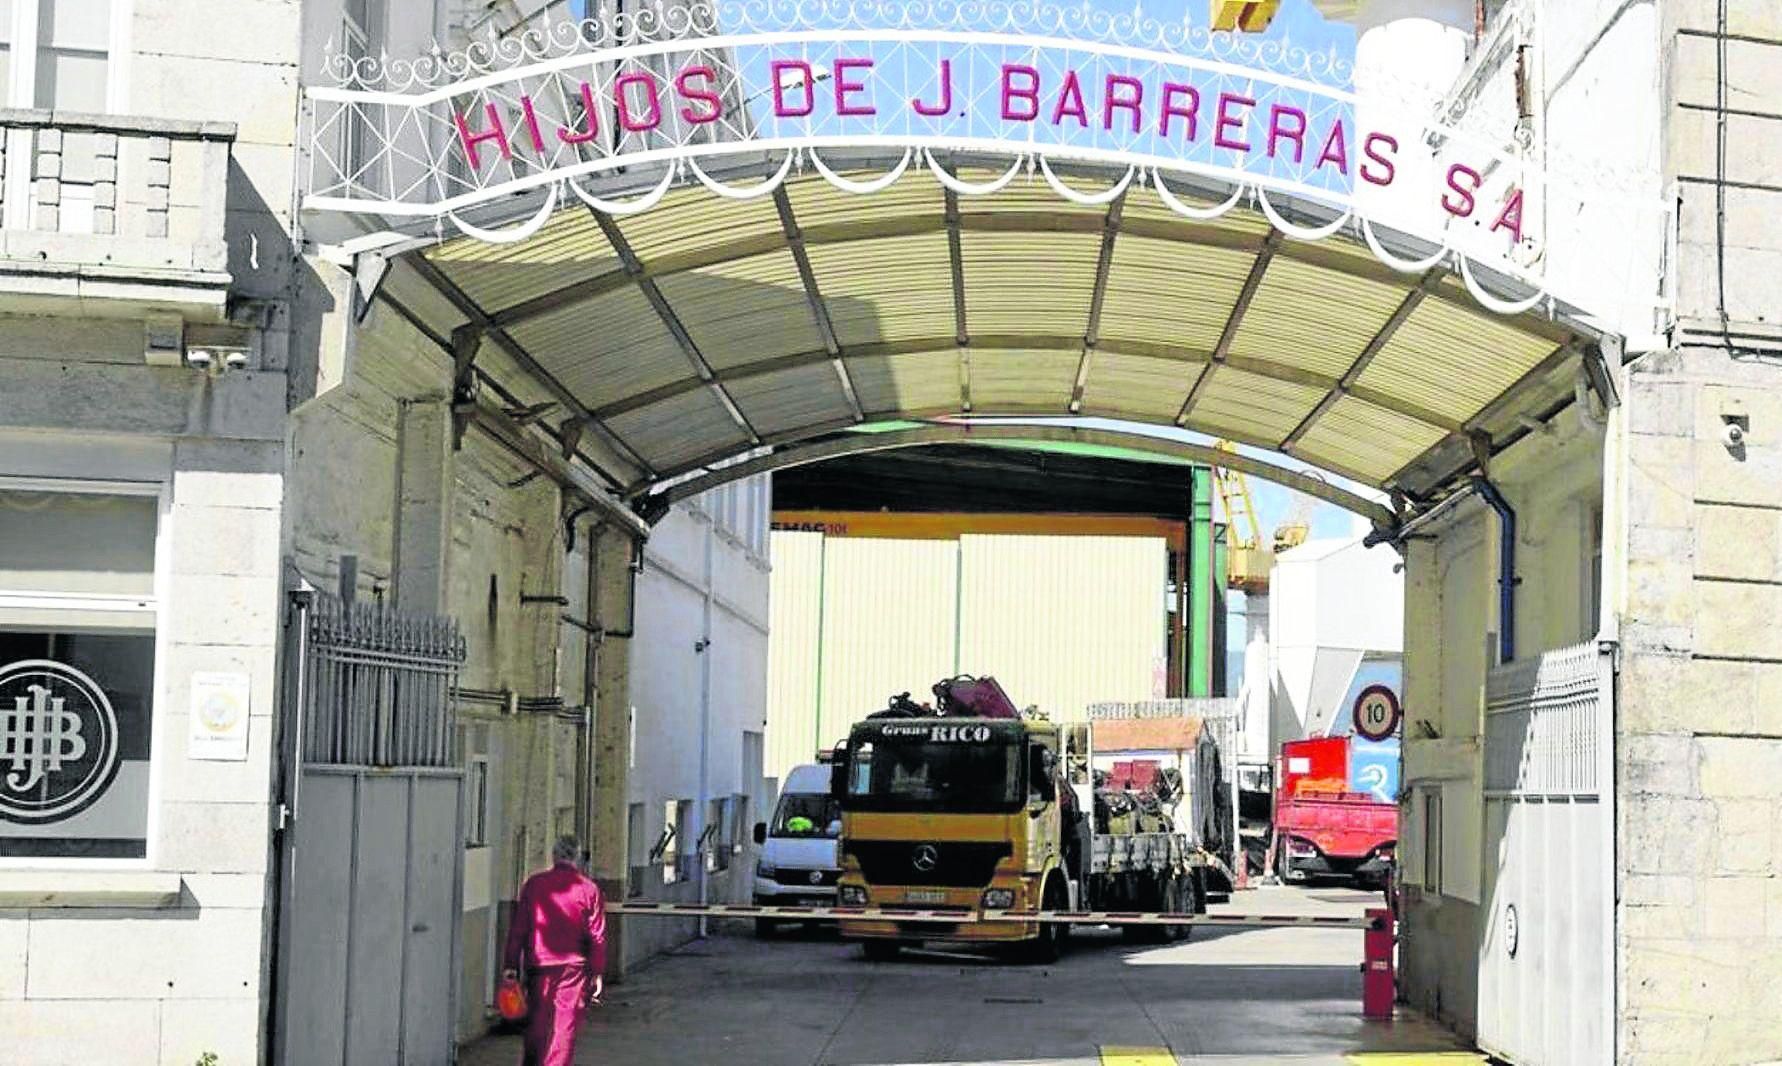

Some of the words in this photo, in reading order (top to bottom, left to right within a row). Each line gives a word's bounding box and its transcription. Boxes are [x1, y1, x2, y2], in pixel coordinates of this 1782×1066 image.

[454, 65, 723, 170] HIJOS
[773, 59, 876, 117] DE
[1001, 64, 1398, 187] BARRERAS
[1367, 703, 1385, 724] 10
[930, 726, 990, 742] RICO
